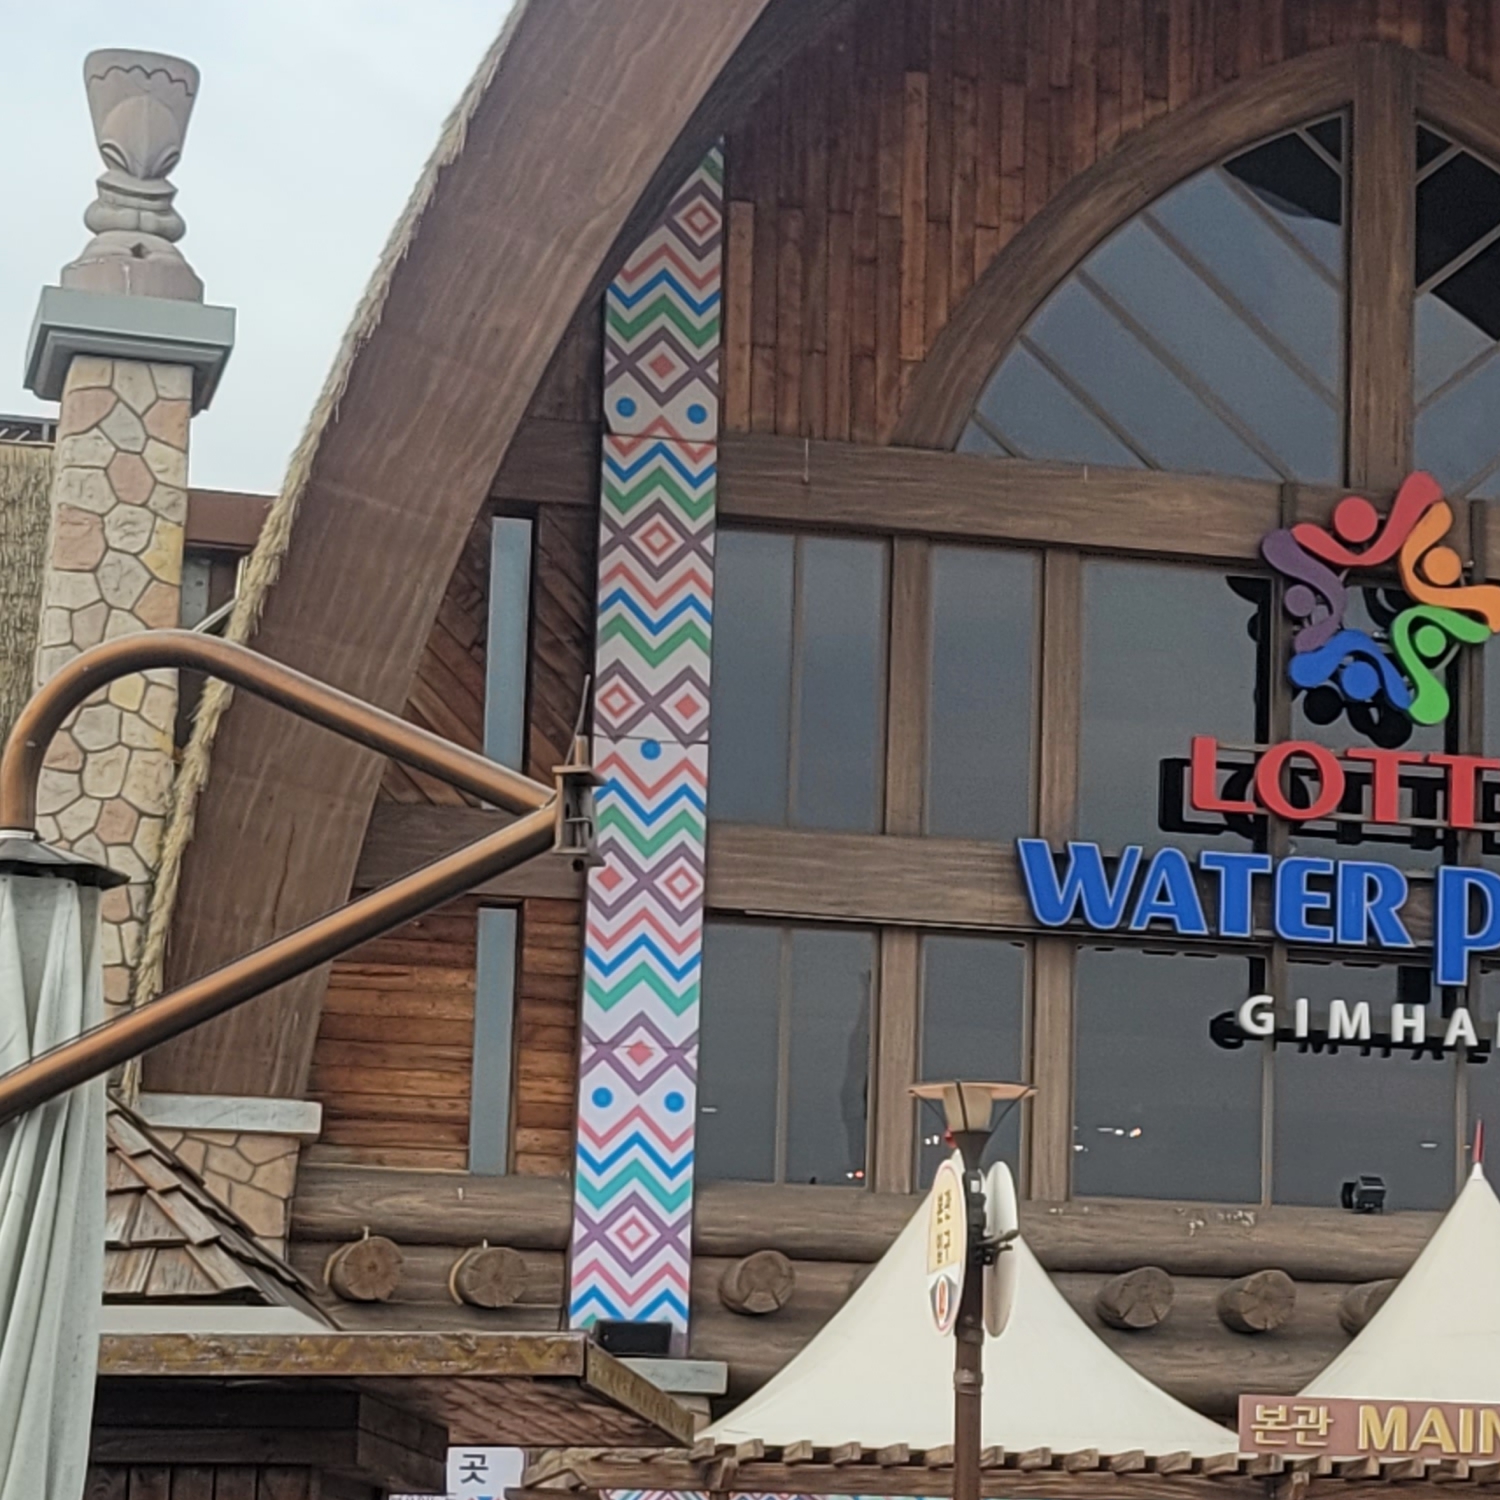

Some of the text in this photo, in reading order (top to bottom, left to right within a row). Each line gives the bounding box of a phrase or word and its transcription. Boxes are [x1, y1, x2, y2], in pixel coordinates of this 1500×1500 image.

[1018, 837, 1415, 948] WATER
[1250, 1405, 1334, 1446] 본관
[459, 1453, 489, 1484] 곳
